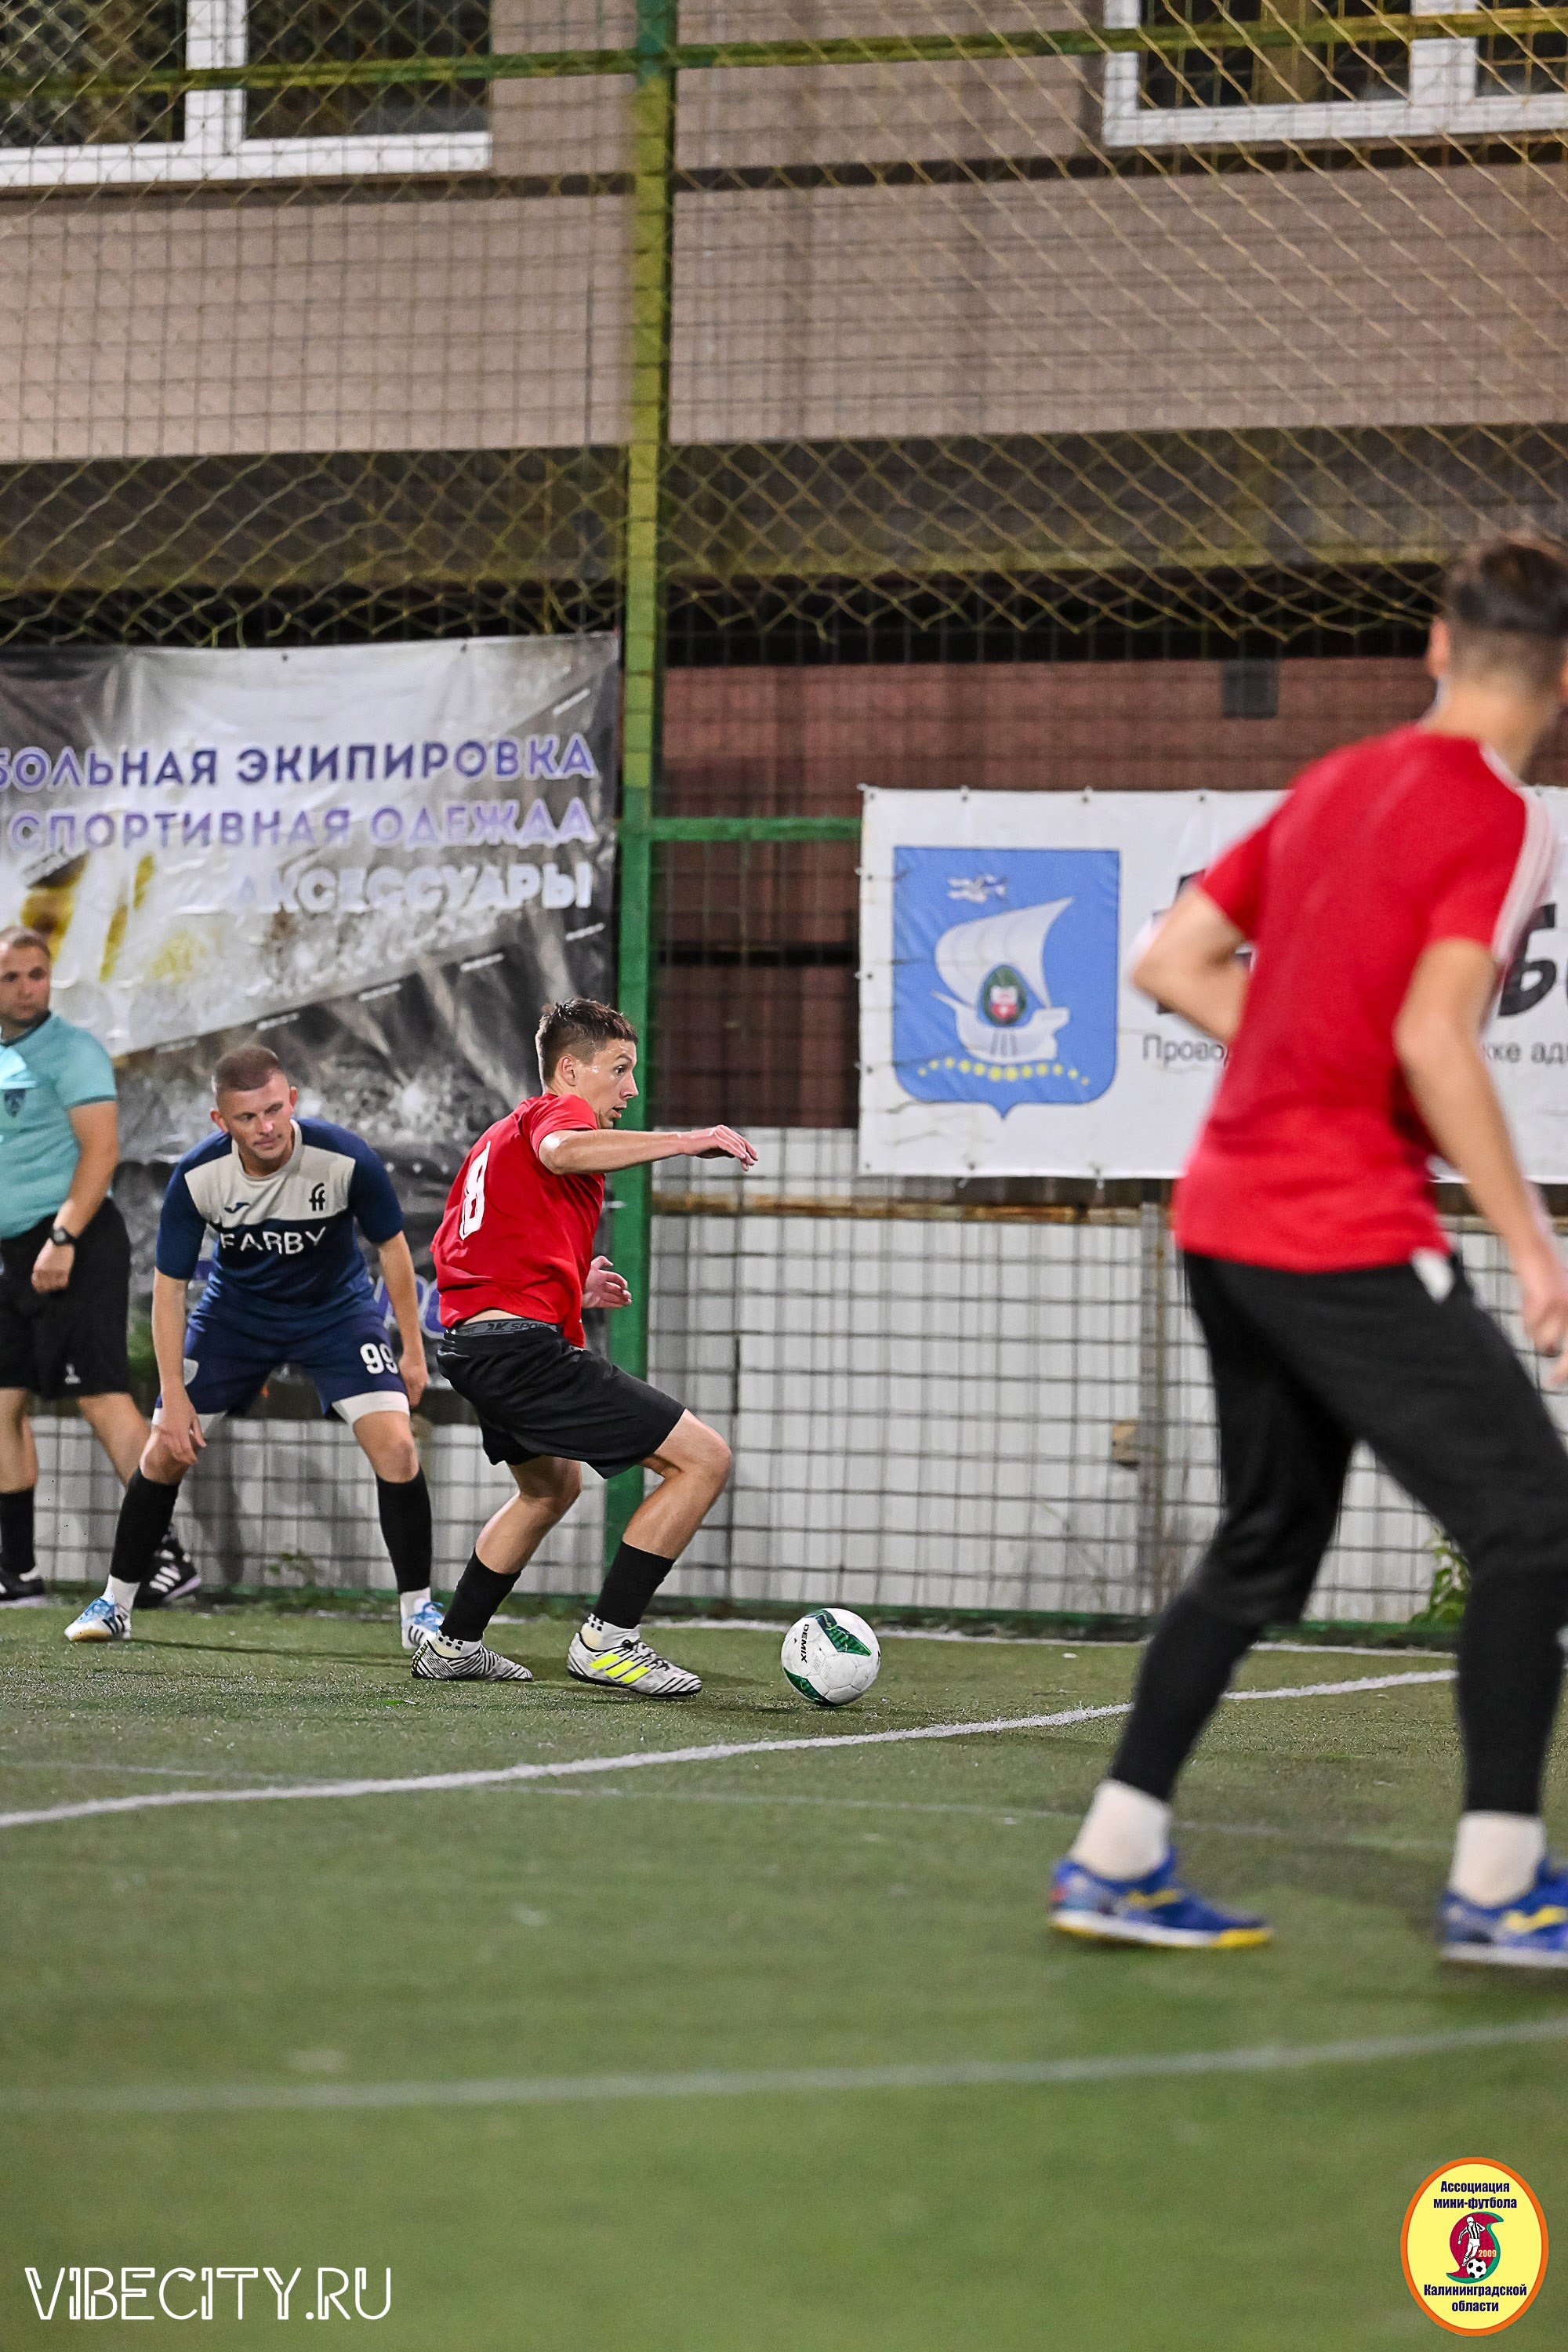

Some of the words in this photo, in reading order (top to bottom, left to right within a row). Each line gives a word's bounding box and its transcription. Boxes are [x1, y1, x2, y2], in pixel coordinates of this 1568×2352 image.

[236, 735, 596, 784] ЭКИПИРОВКА
[10, 808, 351, 850] СПОРТИВНАЯ
[371, 797, 597, 848] ОДЕЖДА
[236, 863, 593, 911] АКСЕССУАРЫ
[1142, 1033, 1229, 1068] Прово
[1530, 1041, 1568, 1065] ад
[459, 1140, 491, 1241] 8
[220, 1226, 326, 1255] FARBY
[360, 1342, 399, 1374] 99
[800, 1624, 810, 1664] DEMIX
